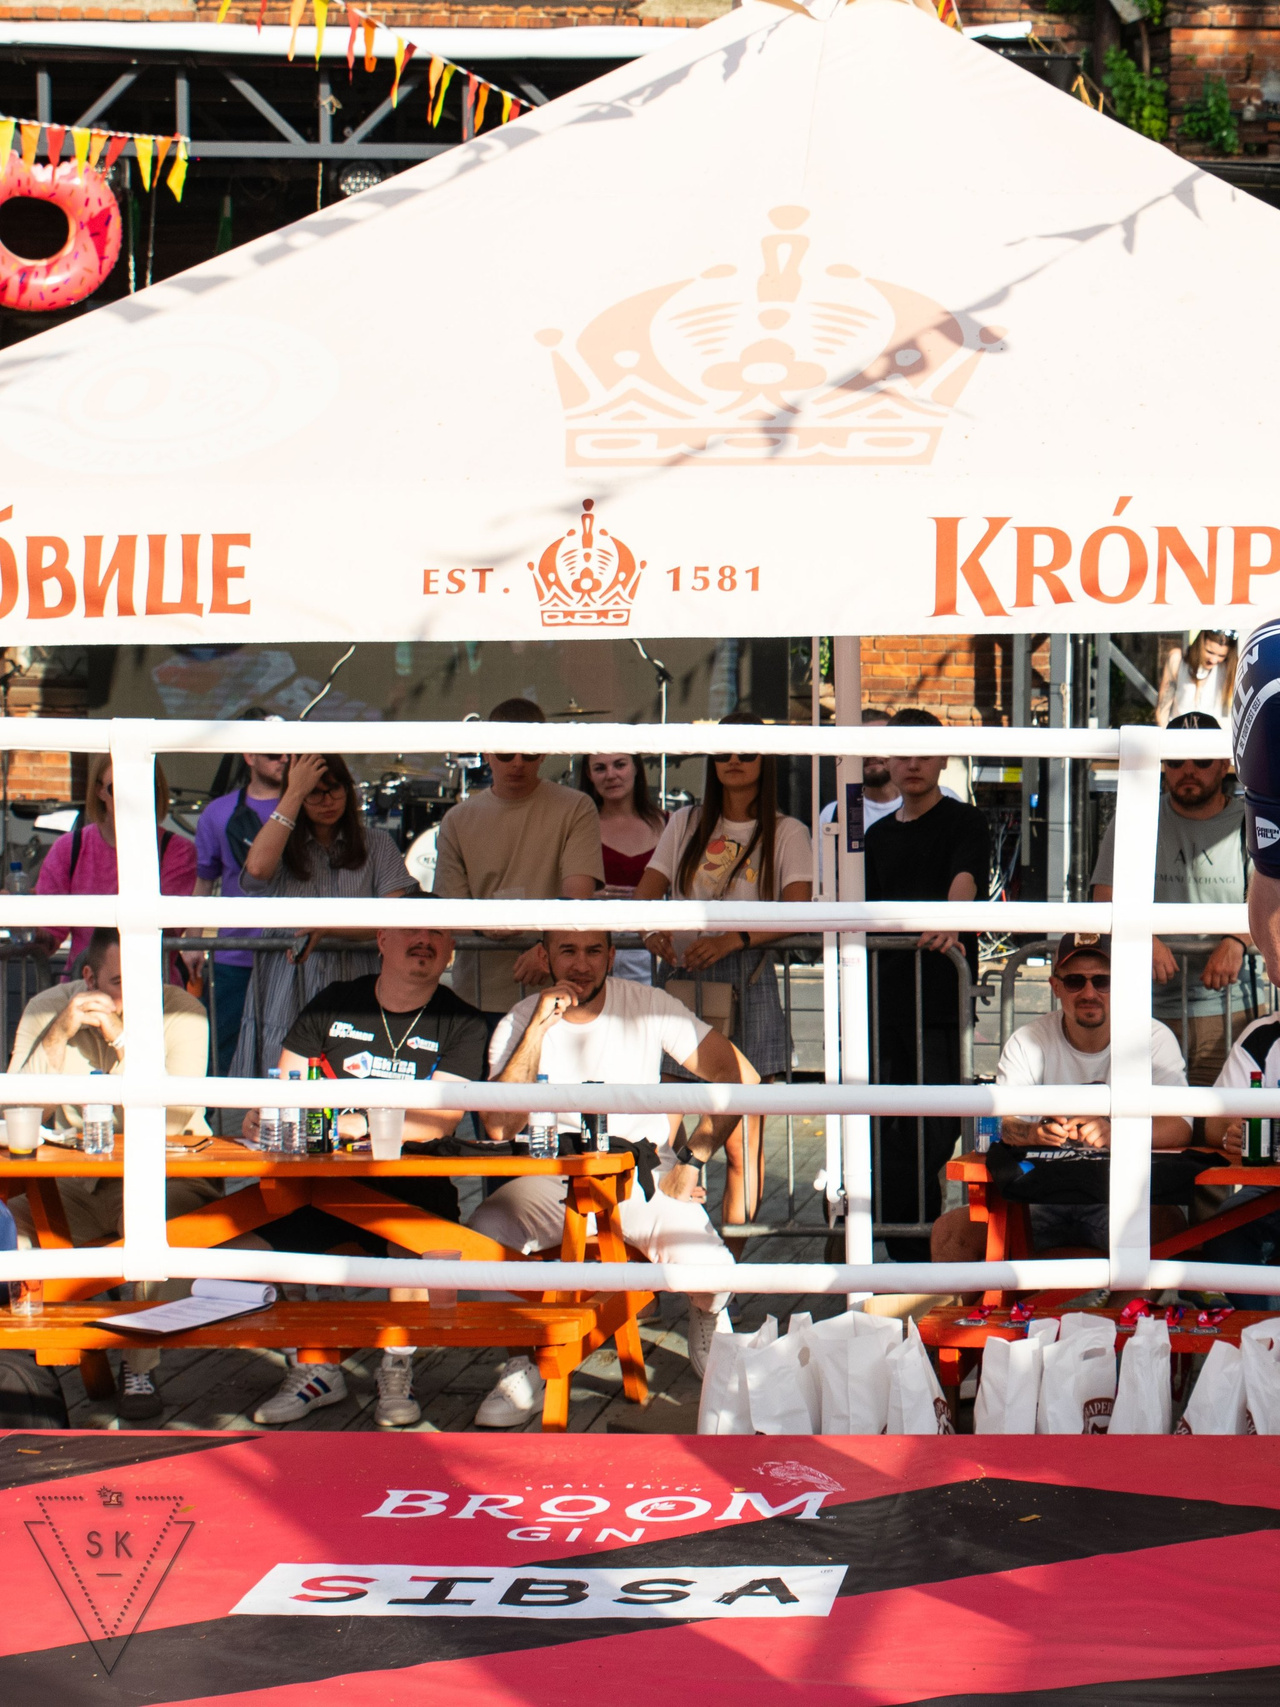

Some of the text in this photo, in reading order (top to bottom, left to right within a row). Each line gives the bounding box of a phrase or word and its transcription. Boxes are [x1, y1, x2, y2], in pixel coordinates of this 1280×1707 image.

[0, 504, 251, 619] ВИЦЕ
[422, 567, 510, 595] EST.
[665, 565, 761, 592] 1581
[1256, 826, 1280, 835] GREEN
[1257, 829, 1277, 840] HILL
[1157, 873, 1185, 884] MANI
[525, 1483, 606, 1491] SMALL
[362, 1489, 835, 1522] BROOM
[506, 1526, 646, 1543] GIN
[288, 1575, 800, 1606] SIBSA
